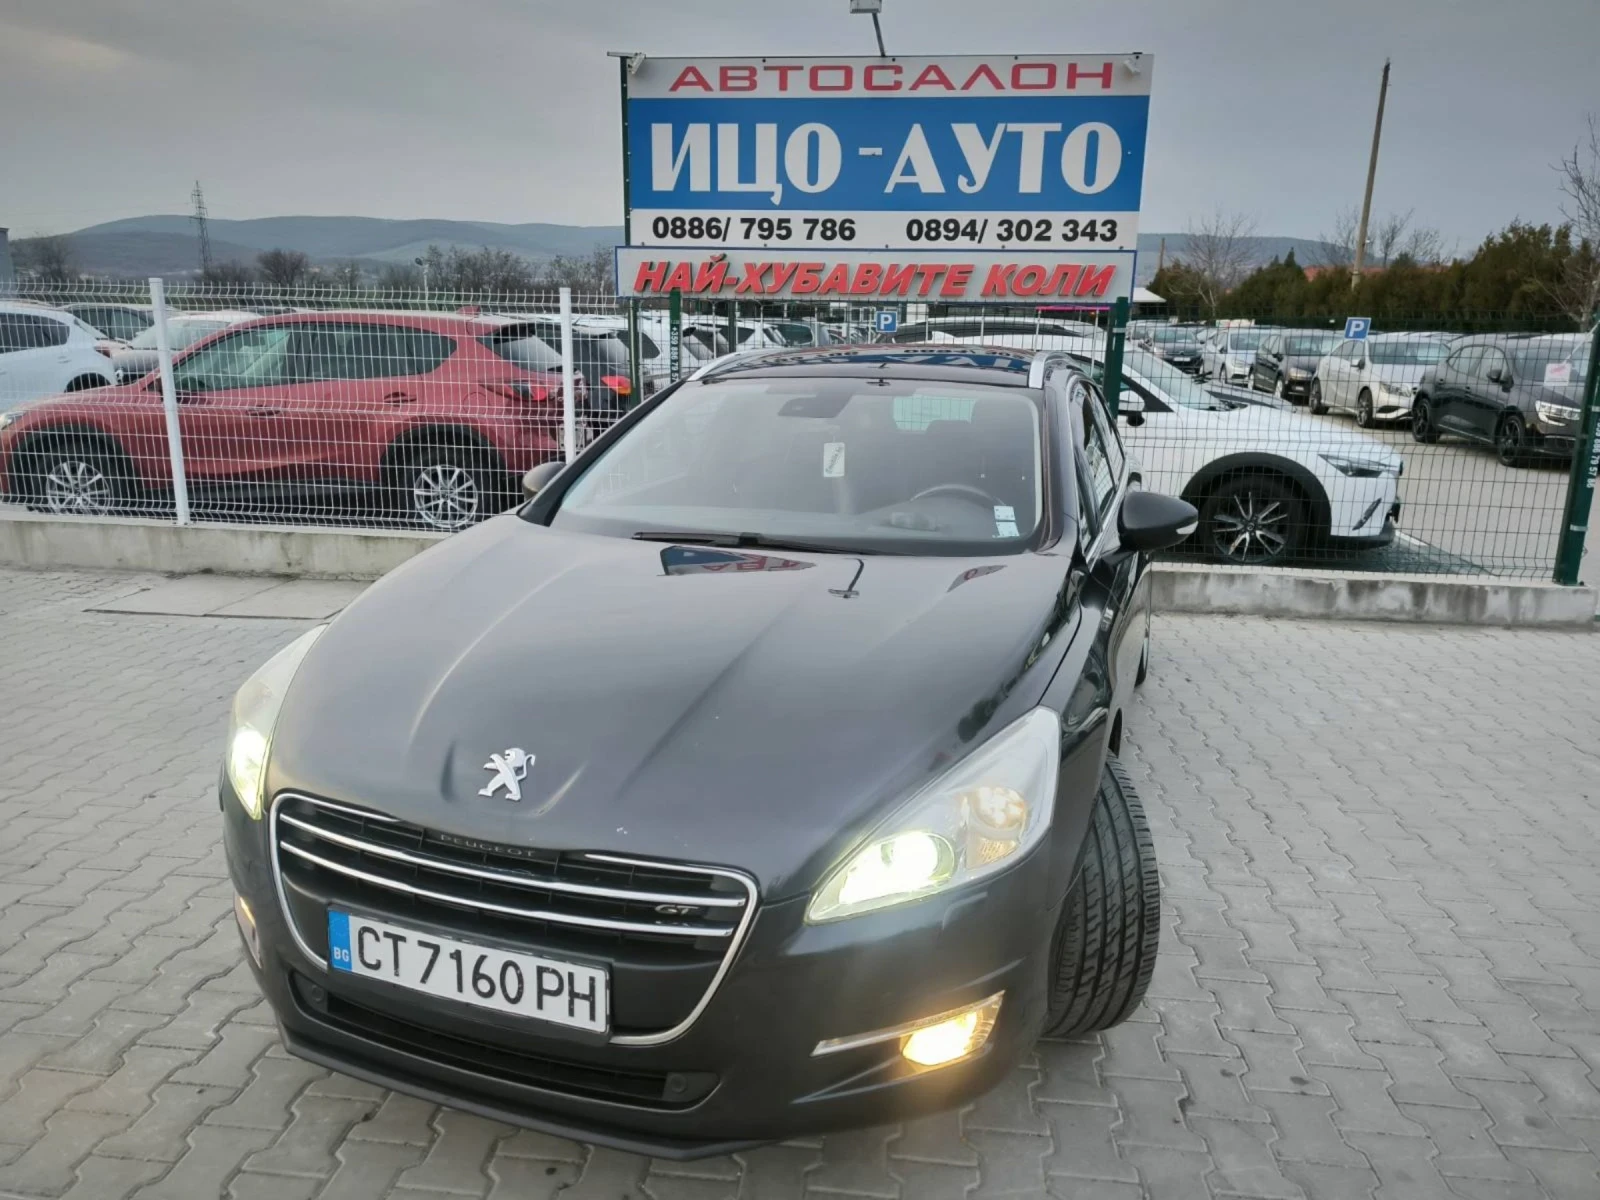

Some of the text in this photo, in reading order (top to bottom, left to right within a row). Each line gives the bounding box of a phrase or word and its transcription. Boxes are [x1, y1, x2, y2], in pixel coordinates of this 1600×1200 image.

[668, 63, 1113, 92] АВТОСАЛОН
[652, 216, 1117, 244] 0886/ 795 786 0894/ 302 343
[633, 253, 1117, 297] НАЙ-ХУБАВИТЕ КОЛИ
[880, 313, 893, 330] P
[1348, 320, 1365, 337] P
[440, 834, 536, 857] PEUGEOT
[655, 904, 700, 916] GT
[333, 946, 350, 963] BG
